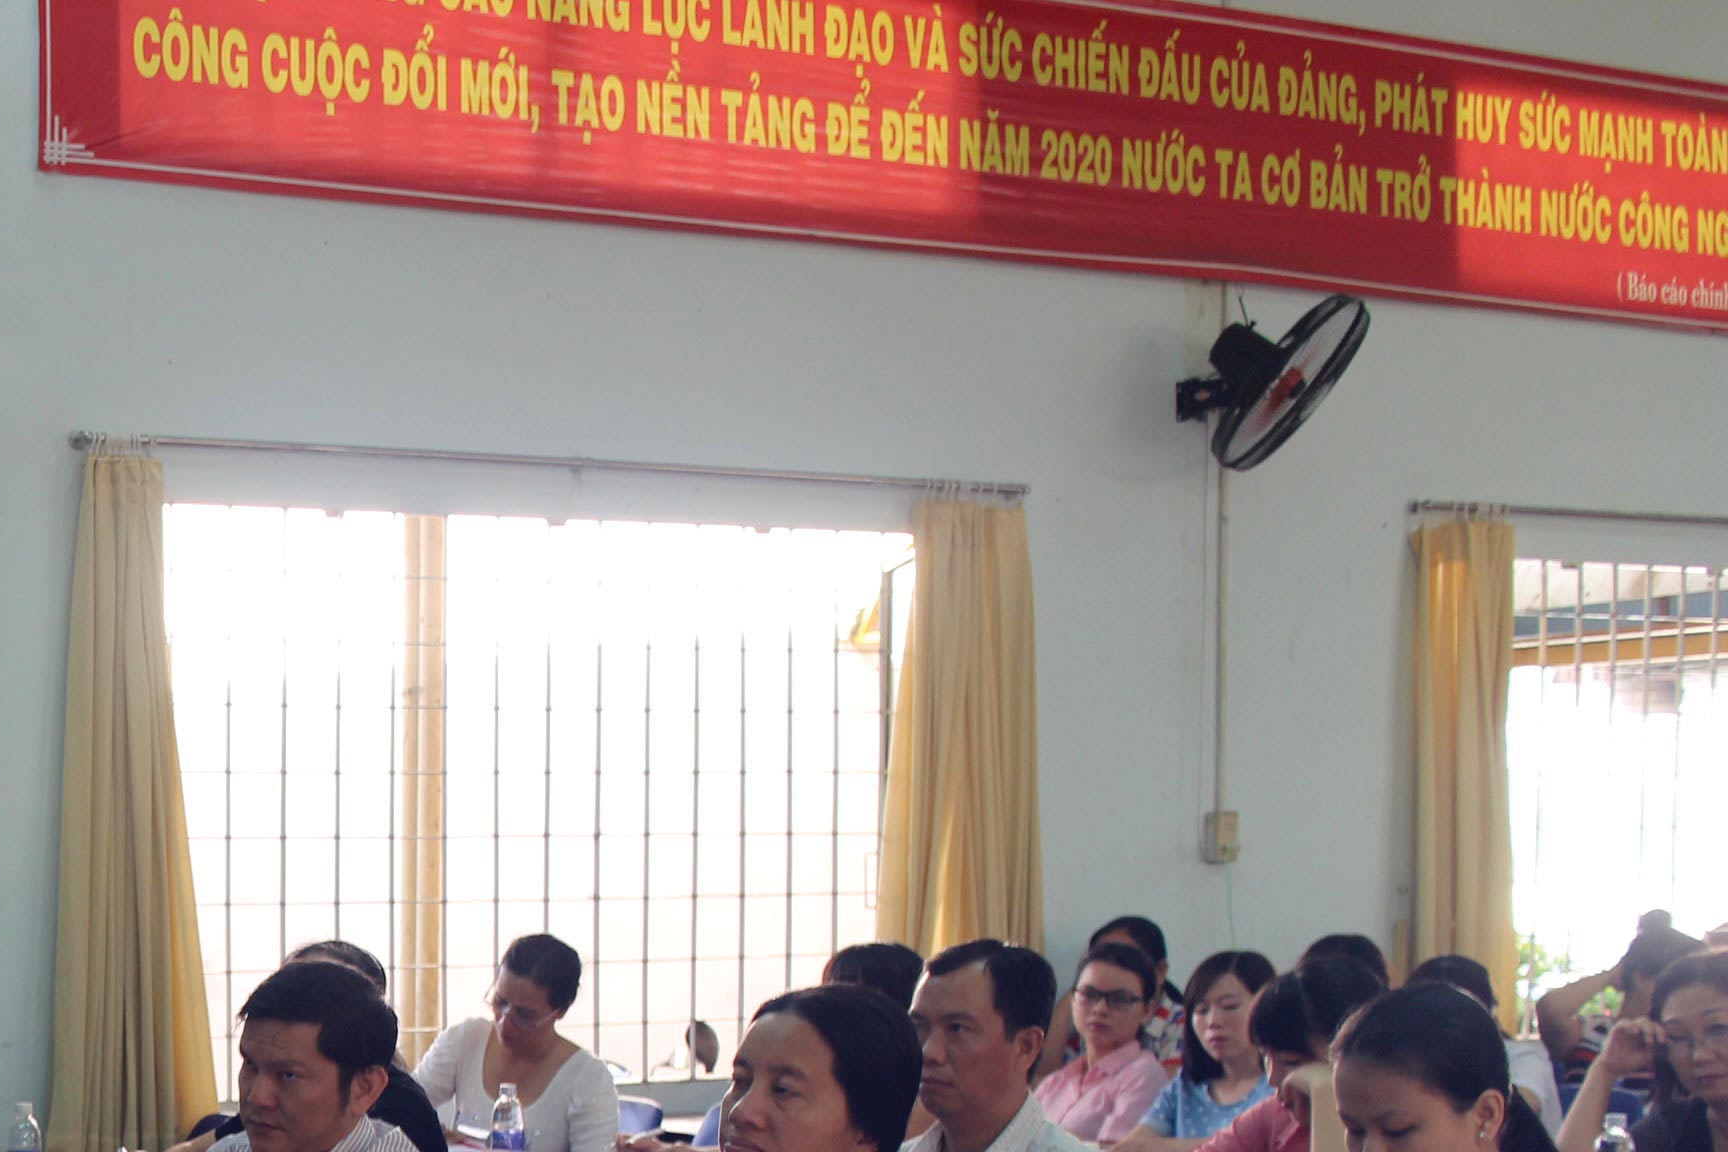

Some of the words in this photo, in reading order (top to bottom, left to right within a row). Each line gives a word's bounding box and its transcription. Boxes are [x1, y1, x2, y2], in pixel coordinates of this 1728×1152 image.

[133, 7, 249, 89] CÔNG
[261, 26, 371, 116] CUỘC
[381, 23, 448, 111] ĐỔI
[460, 46, 540, 134] MỚI,
[551, 69, 626, 144] TẠO
[636, 59, 711, 141] NỀN
[720, 70, 816, 153] TẢNG
[825, 78, 872, 160] ĐỂ
[880, 88, 949, 168] ĐẾN
[958, 108, 1030, 177] NĂM
[1039, 128, 1112, 186] 2020
[1122, 128, 1206, 197] NƯỚC
[1215, 148, 1253, 202] TA
[1261, 147, 1301, 208] CƠ
[1310, 143, 1368, 214] BẢN
[1376, 153, 1432, 223] TRỞ
[1439, 166, 1533, 234] THÀNH
[1540, 180, 1612, 245] NƯỚC
[1618, 189, 1690, 254] CÔNG
[824, 4, 895, 78] ĐẠO
[904, 3, 949, 73] VÀ
[958, 10, 1022, 82] SỨC
[1032, 18, 1129, 95] CHIẾN
[1138, 28, 1202, 105] ĐẤU
[1210, 40, 1270, 114] CỦA
[1278, 49, 1366, 136] ĐẢNG,
[1375, 71, 1449, 137] PHÁT
[1456, 91, 1513, 145] HUY
[1519, 89, 1571, 154] SỨC
[1578, 107, 1654, 174] MẠNH
[1660, 112, 1728, 175] TOÀN
[1661, 275, 1688, 306] cáo
